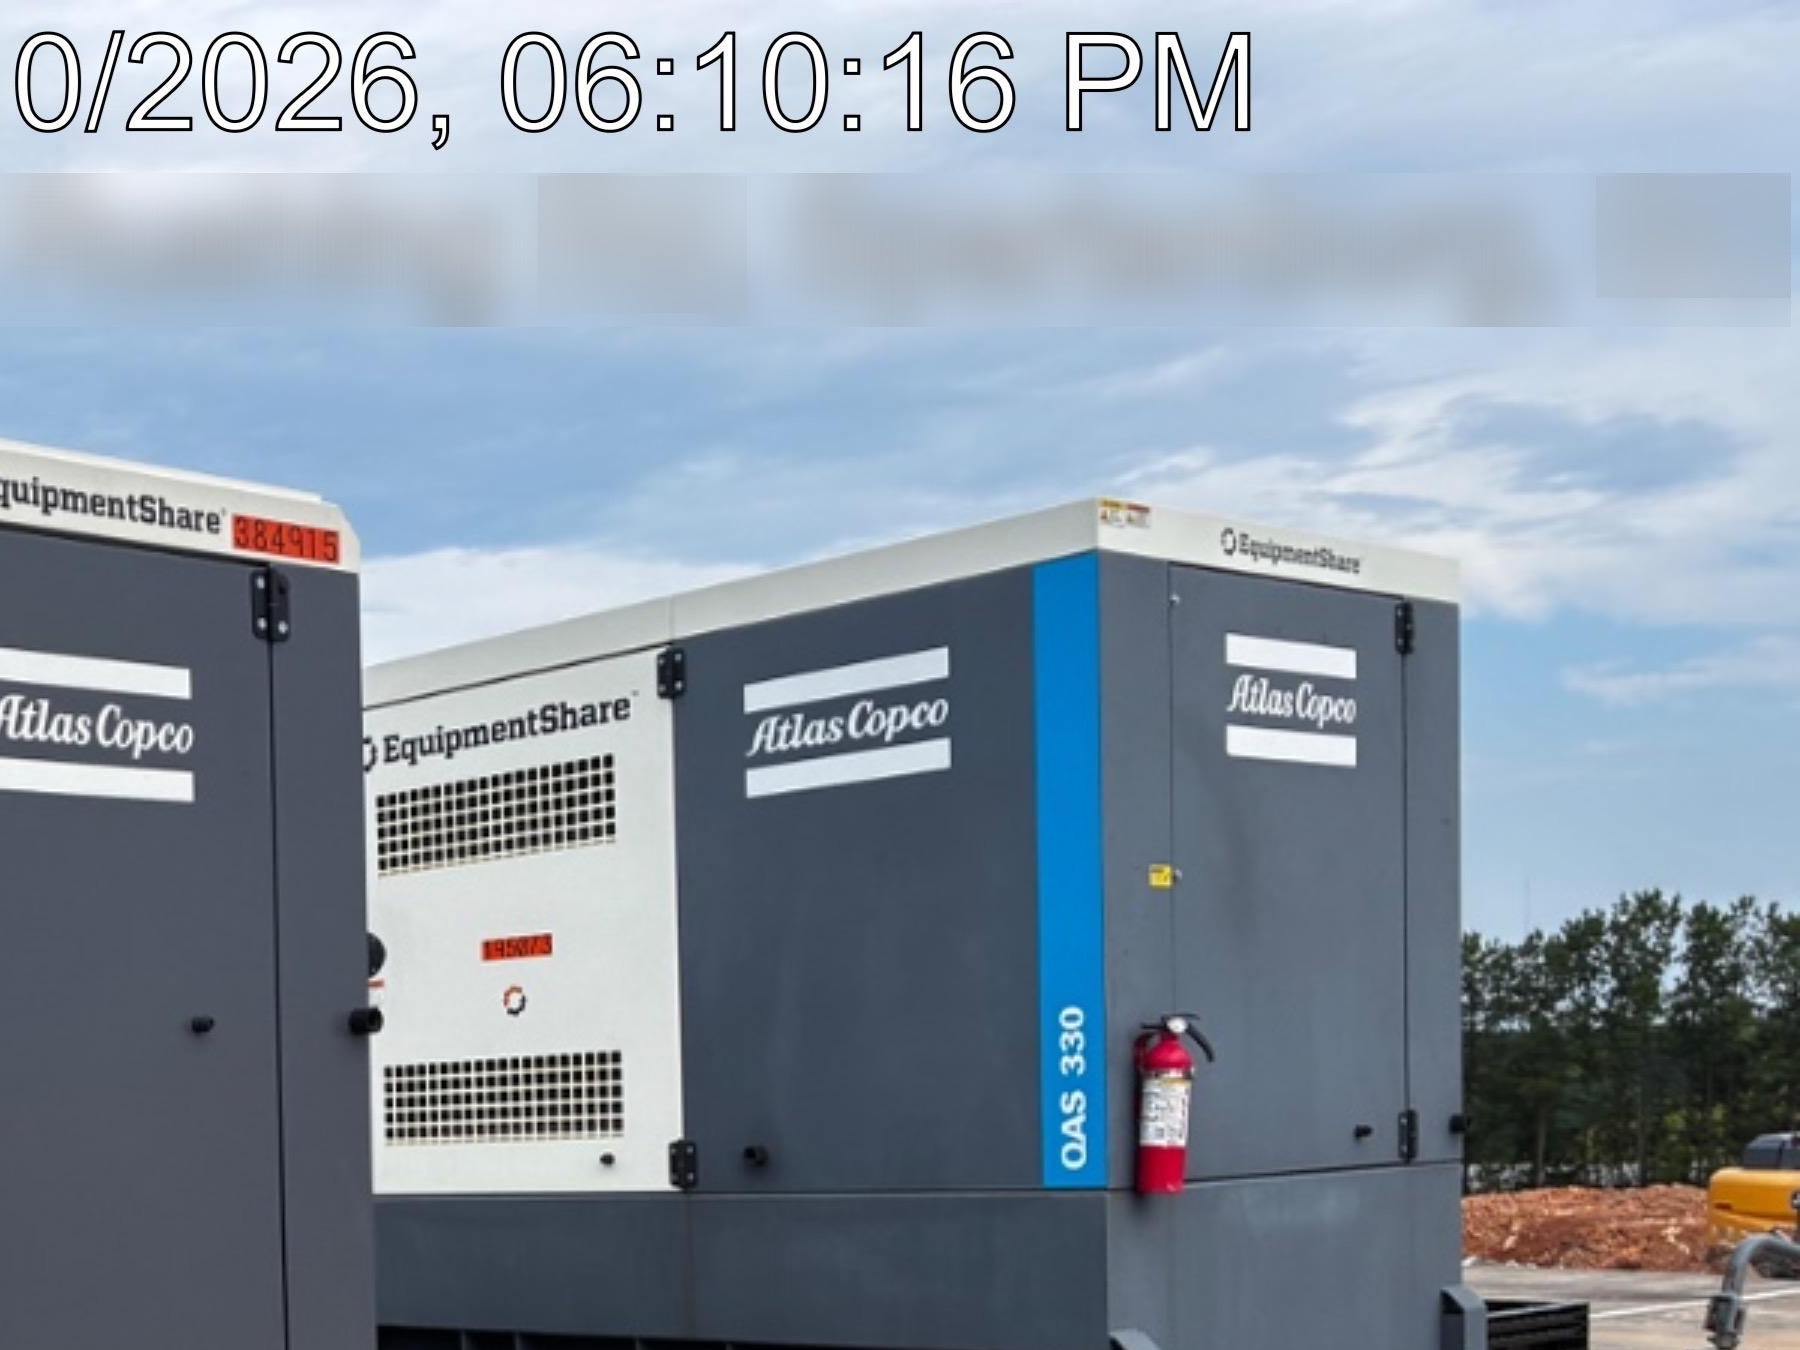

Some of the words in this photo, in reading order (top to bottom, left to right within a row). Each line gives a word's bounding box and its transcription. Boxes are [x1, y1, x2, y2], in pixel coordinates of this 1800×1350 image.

[233, 516, 339, 562] 384915
[1237, 532, 1362, 575] EquipmentShare
[746, 711, 845, 758] Atlas
[846, 697, 950, 746] Copco
[1226, 674, 1294, 717] Atlas
[1296, 682, 1358, 728] Copco
[96, 703, 194, 760] Copco
[382, 695, 632, 769] EquipmentShare
[1058, 1005, 1087, 1076] 330
[1059, 1089, 1088, 1171] QAS
